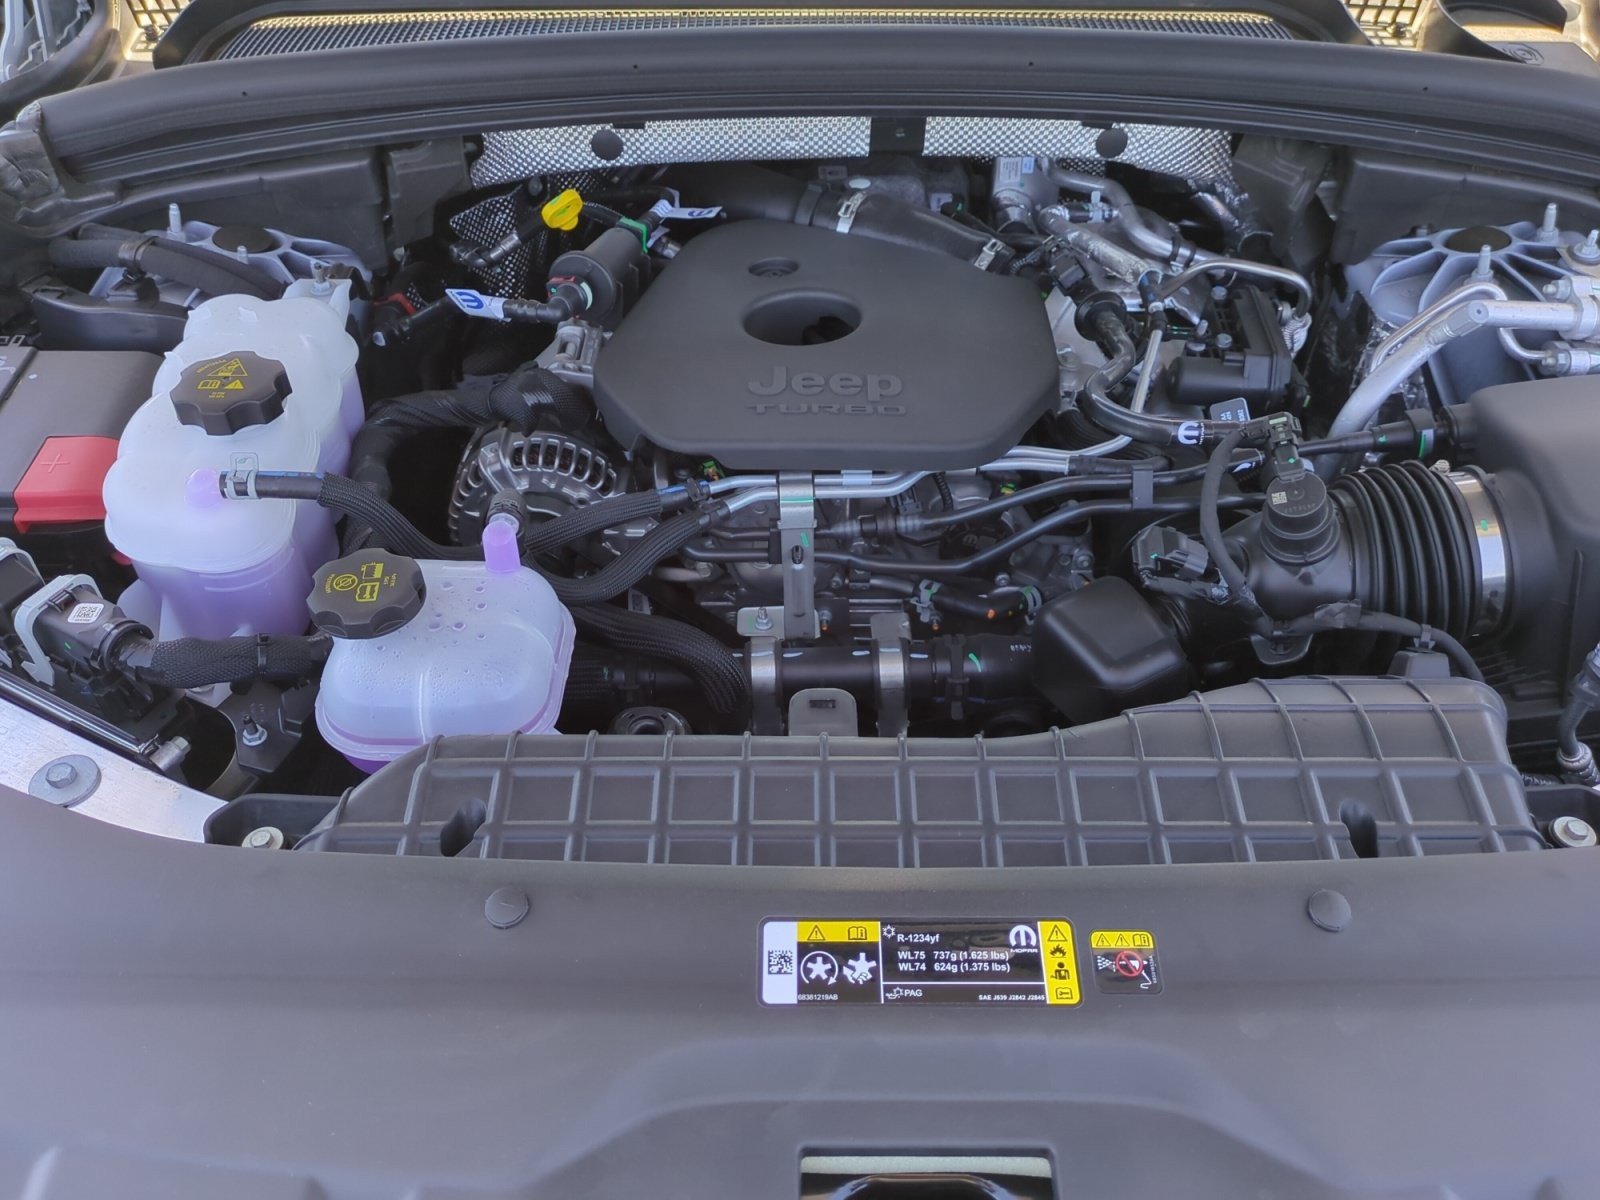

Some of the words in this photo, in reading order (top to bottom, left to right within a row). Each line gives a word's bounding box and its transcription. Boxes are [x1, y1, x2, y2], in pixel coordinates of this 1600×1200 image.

[748, 366, 903, 402] Jeep
[747, 403, 907, 416] TURBO
[897, 933, 940, 945] R-1234yf
[898, 951, 926, 960] WL75
[933, 951, 957, 962] 737g
[959, 951, 989, 961] (1.625
[991, 950, 1009, 961] lbs)
[898, 962, 926, 971] WL74
[934, 962, 957, 973] 624g
[960, 962, 989, 972] (1.375
[991, 962, 1010, 973] lbs)
[904, 989, 923, 997] PAG
